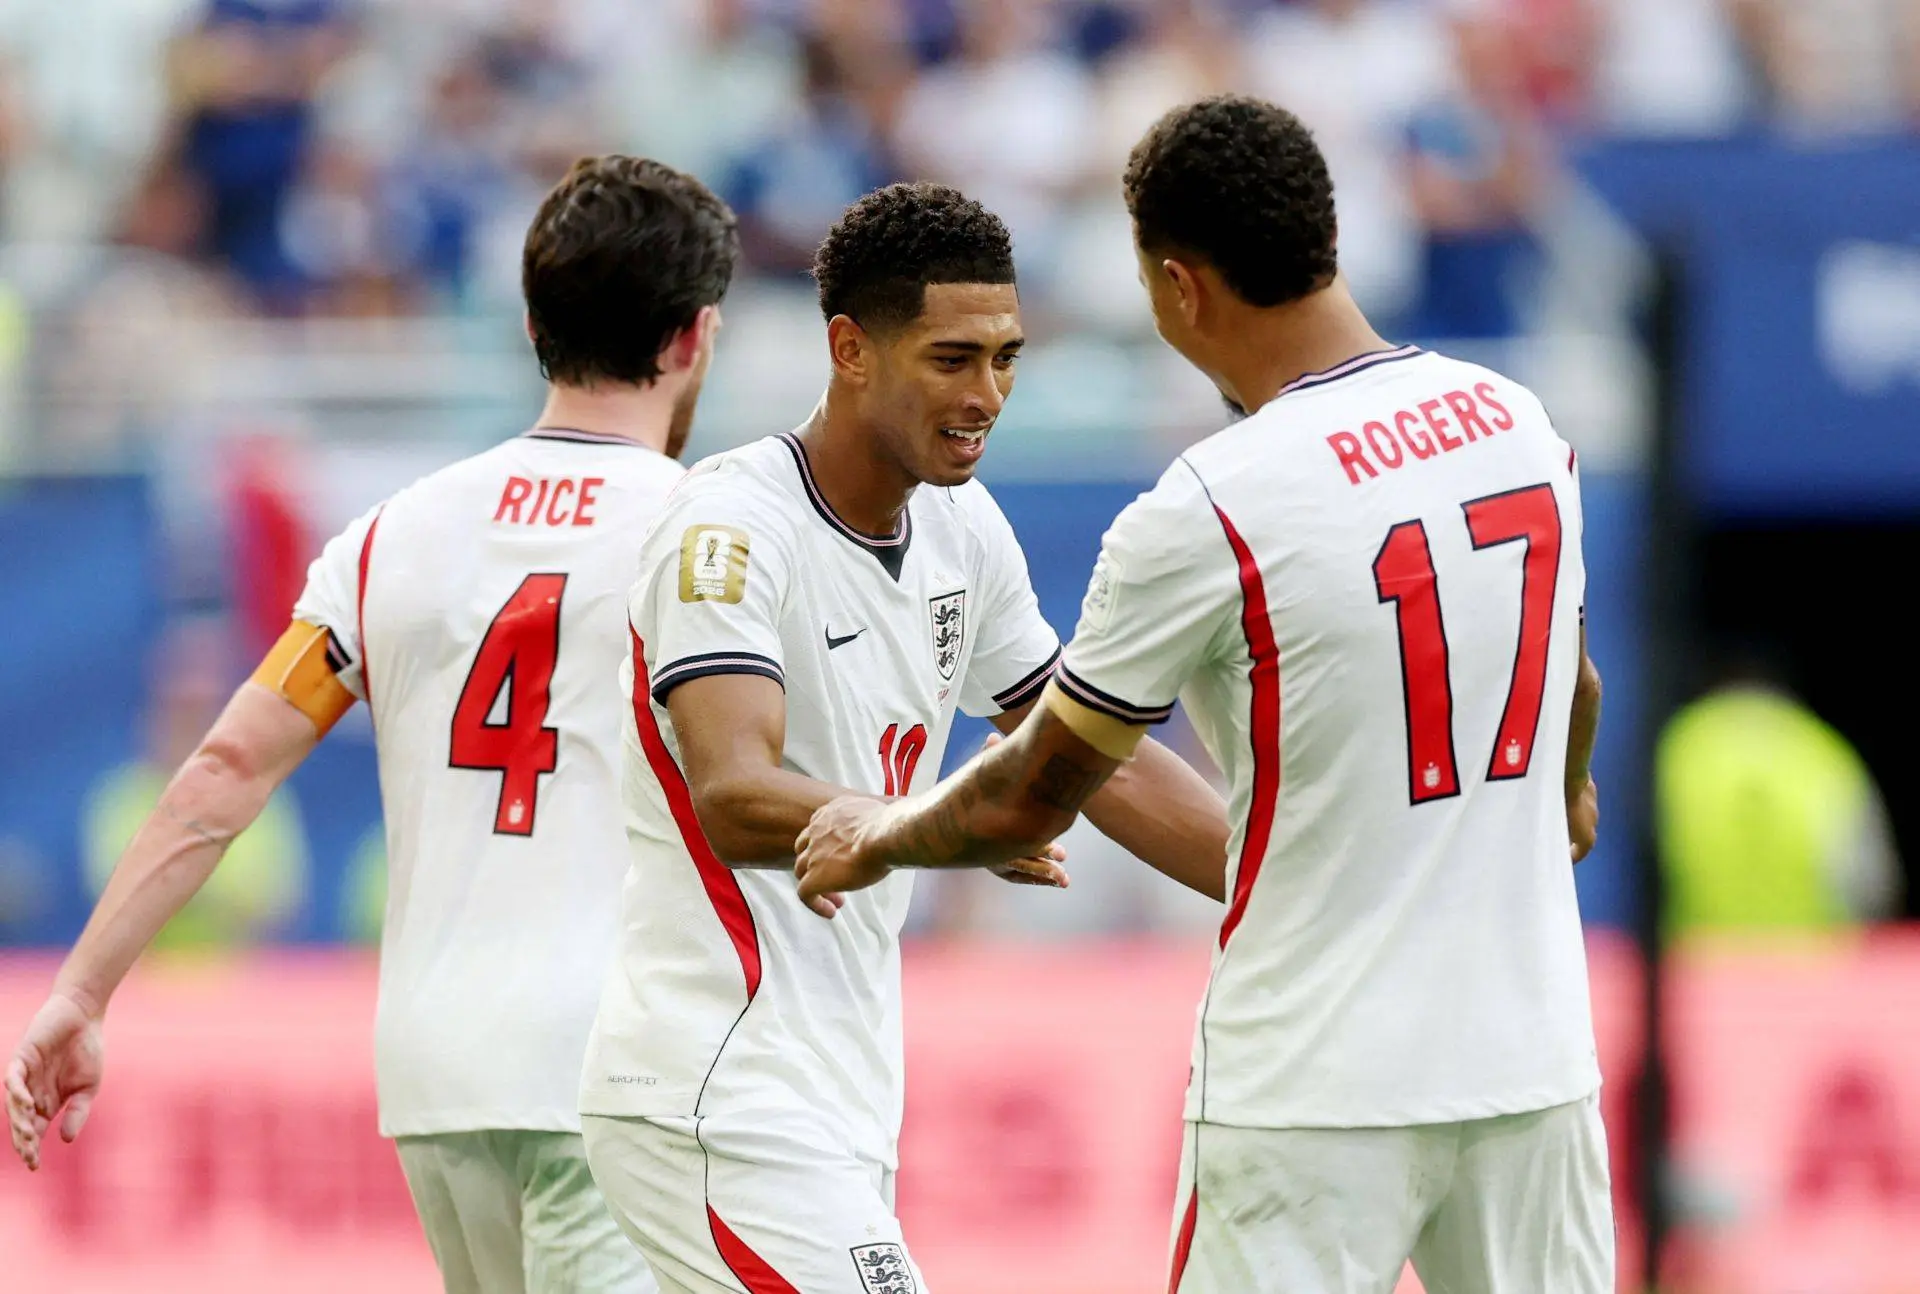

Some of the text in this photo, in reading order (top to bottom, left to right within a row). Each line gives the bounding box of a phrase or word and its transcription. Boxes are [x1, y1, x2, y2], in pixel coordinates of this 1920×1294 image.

[1326, 382, 1514, 486] ROGERS
[493, 476, 605, 526] RICE
[1372, 482, 1562, 806] 17
[448, 573, 569, 837] 4
[878, 723, 928, 796] 10
